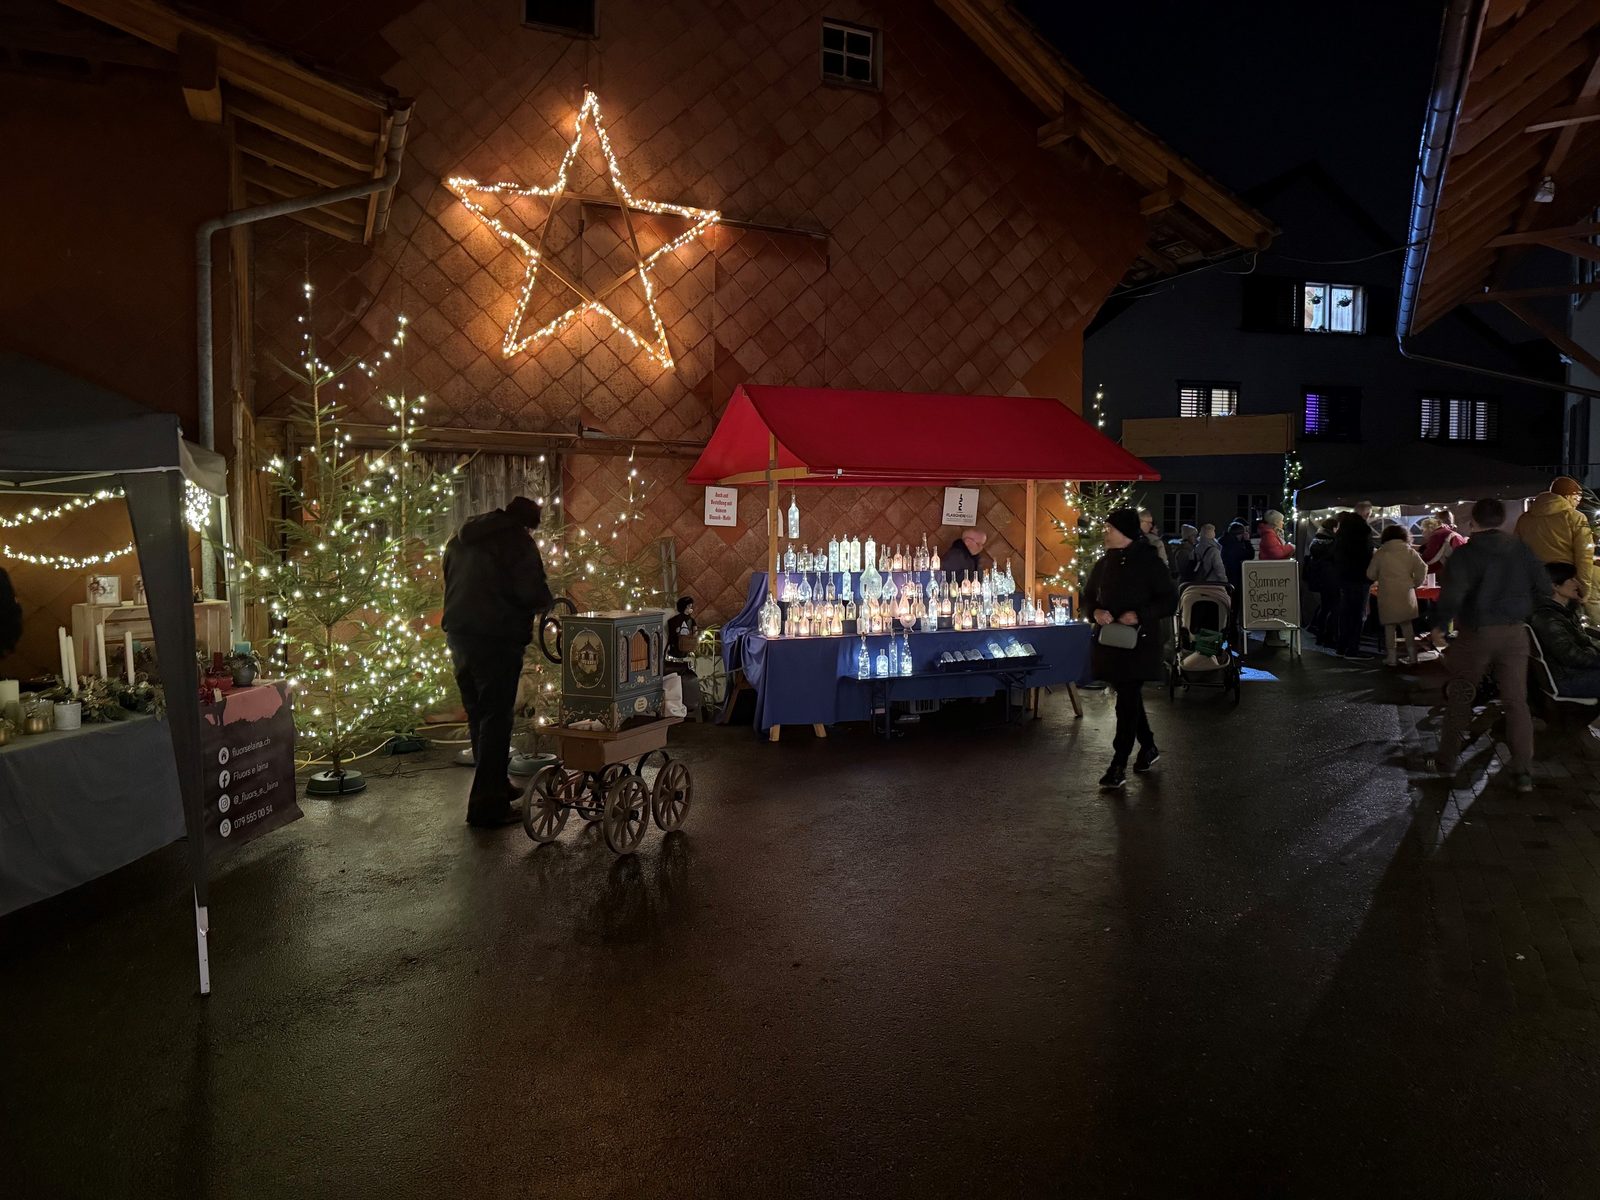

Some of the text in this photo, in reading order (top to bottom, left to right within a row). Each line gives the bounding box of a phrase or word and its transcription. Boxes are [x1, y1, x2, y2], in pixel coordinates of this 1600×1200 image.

[1248, 571, 1290, 589] Stammer
[1250, 603, 1287, 619] Suppe
[252, 767, 256, 775] e
[233, 804, 273, 829] 079 555 00 54
